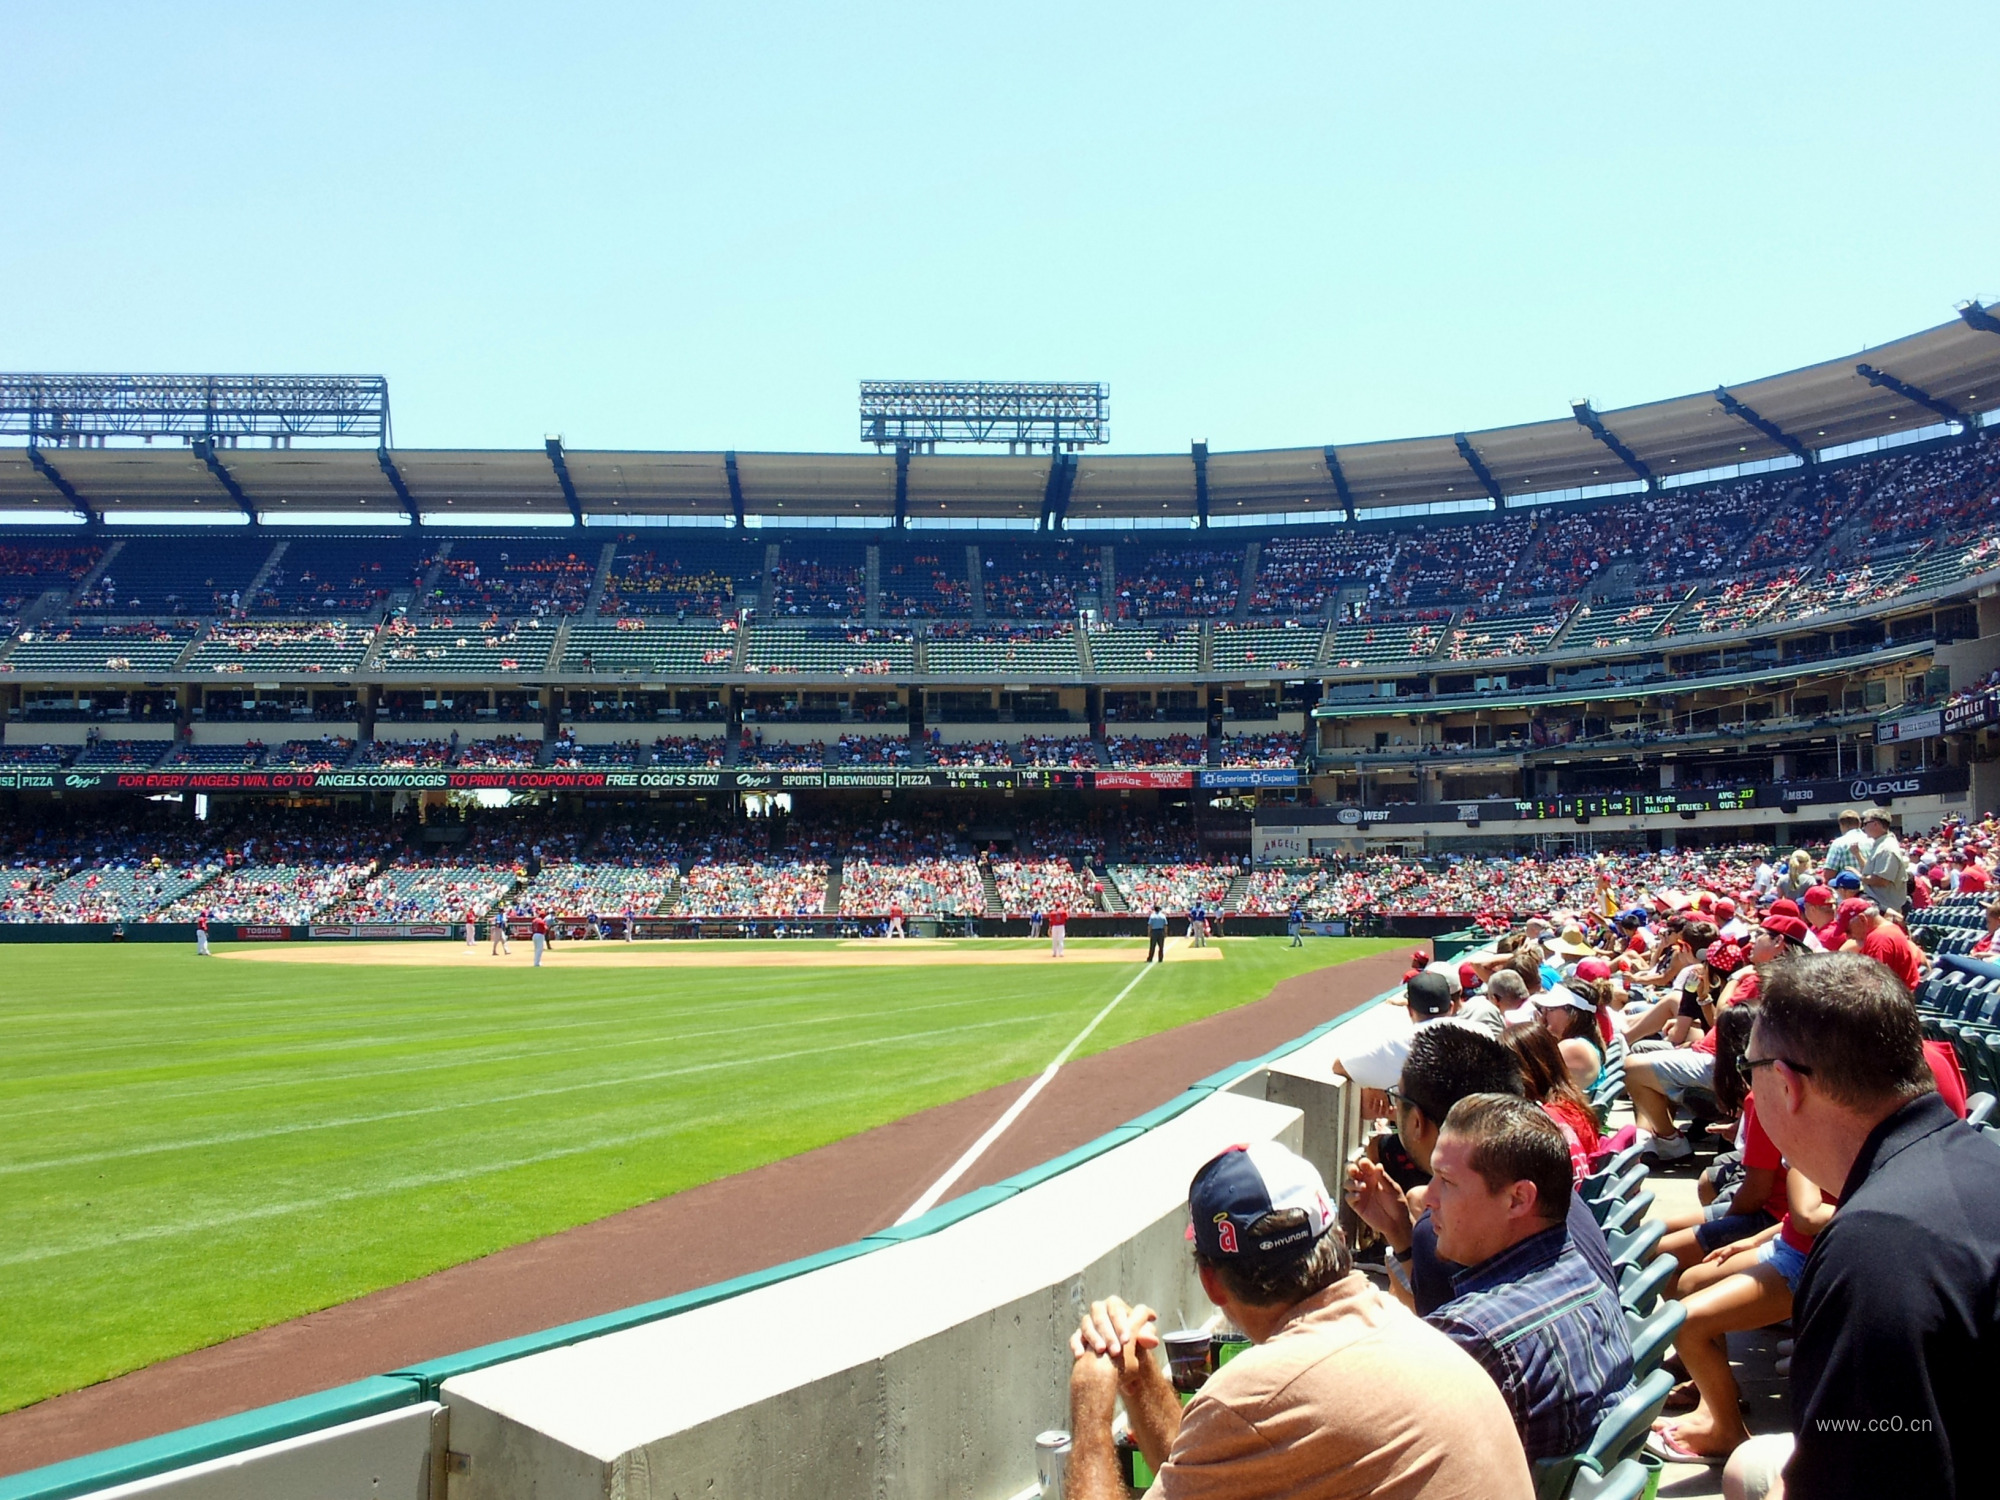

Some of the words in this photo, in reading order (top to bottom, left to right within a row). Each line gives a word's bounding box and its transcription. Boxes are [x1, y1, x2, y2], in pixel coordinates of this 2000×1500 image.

[1044, 771, 1050, 779] 1
[1216, 775, 1248, 784] Experian
[1262, 773, 1295, 784] Experian
[22, 776, 53, 787] PIZZA
[65, 774, 101, 788] Oggi's
[117, 775, 146, 787] FOR
[146, 775, 186, 787] EVERY
[188, 775, 240, 787] ANGELS
[242, 775, 269, 788] WIN,
[272, 775, 293, 787] GO
[296, 775, 314, 787] TO
[315, 774, 447, 787] ANGELS.COM/OGGIS
[449, 775, 467, 787] TO
[468, 775, 506, 787] PRINT
[507, 775, 516, 786] A
[519, 775, 575, 786] COUPON
[577, 775, 604, 786] FOR
[605, 774, 638, 786] FREE
[640, 774, 685, 786] OGGI'S
[687, 774, 719, 786] STIX!
[736, 773, 772, 788] Oggi's
[782, 775, 822, 786] SPORTS
[828, 775, 894, 786] BREWHOUSE
[901, 775, 931, 786] PIZZA
[959, 780, 966, 788] 0
[982, 780, 988, 788] 1
[1005, 780, 1012, 788] 2
[1044, 780, 1050, 788] 2
[1095, 777, 1142, 786] HERITAGE
[1868, 779, 1920, 795] LEXUS
[1718, 791, 1735, 800] AVG:
[1738, 789, 1754, 798] .217
[1625, 797, 1631, 805] 2
[1644, 796, 1653, 804] 31
[1656, 795, 1675, 803] Kratz
[1514, 802, 1532, 810] TOR
[1565, 804, 1571, 812] H
[1577, 799, 1583, 807] 5
[1590, 803, 1596, 811] E
[1645, 806, 1663, 814] BALL:
[1676, 803, 1704, 811] STRIKE:
[1705, 802, 1710, 810] 1
[1719, 801, 1737, 809] OUT:
[1363, 811, 1390, 820] WEST
[1577, 809, 1583, 817] 3
[1602, 808, 1607, 816] 1
[1625, 807, 1631, 815] 2
[1264, 839, 1300, 852] ANGELS
